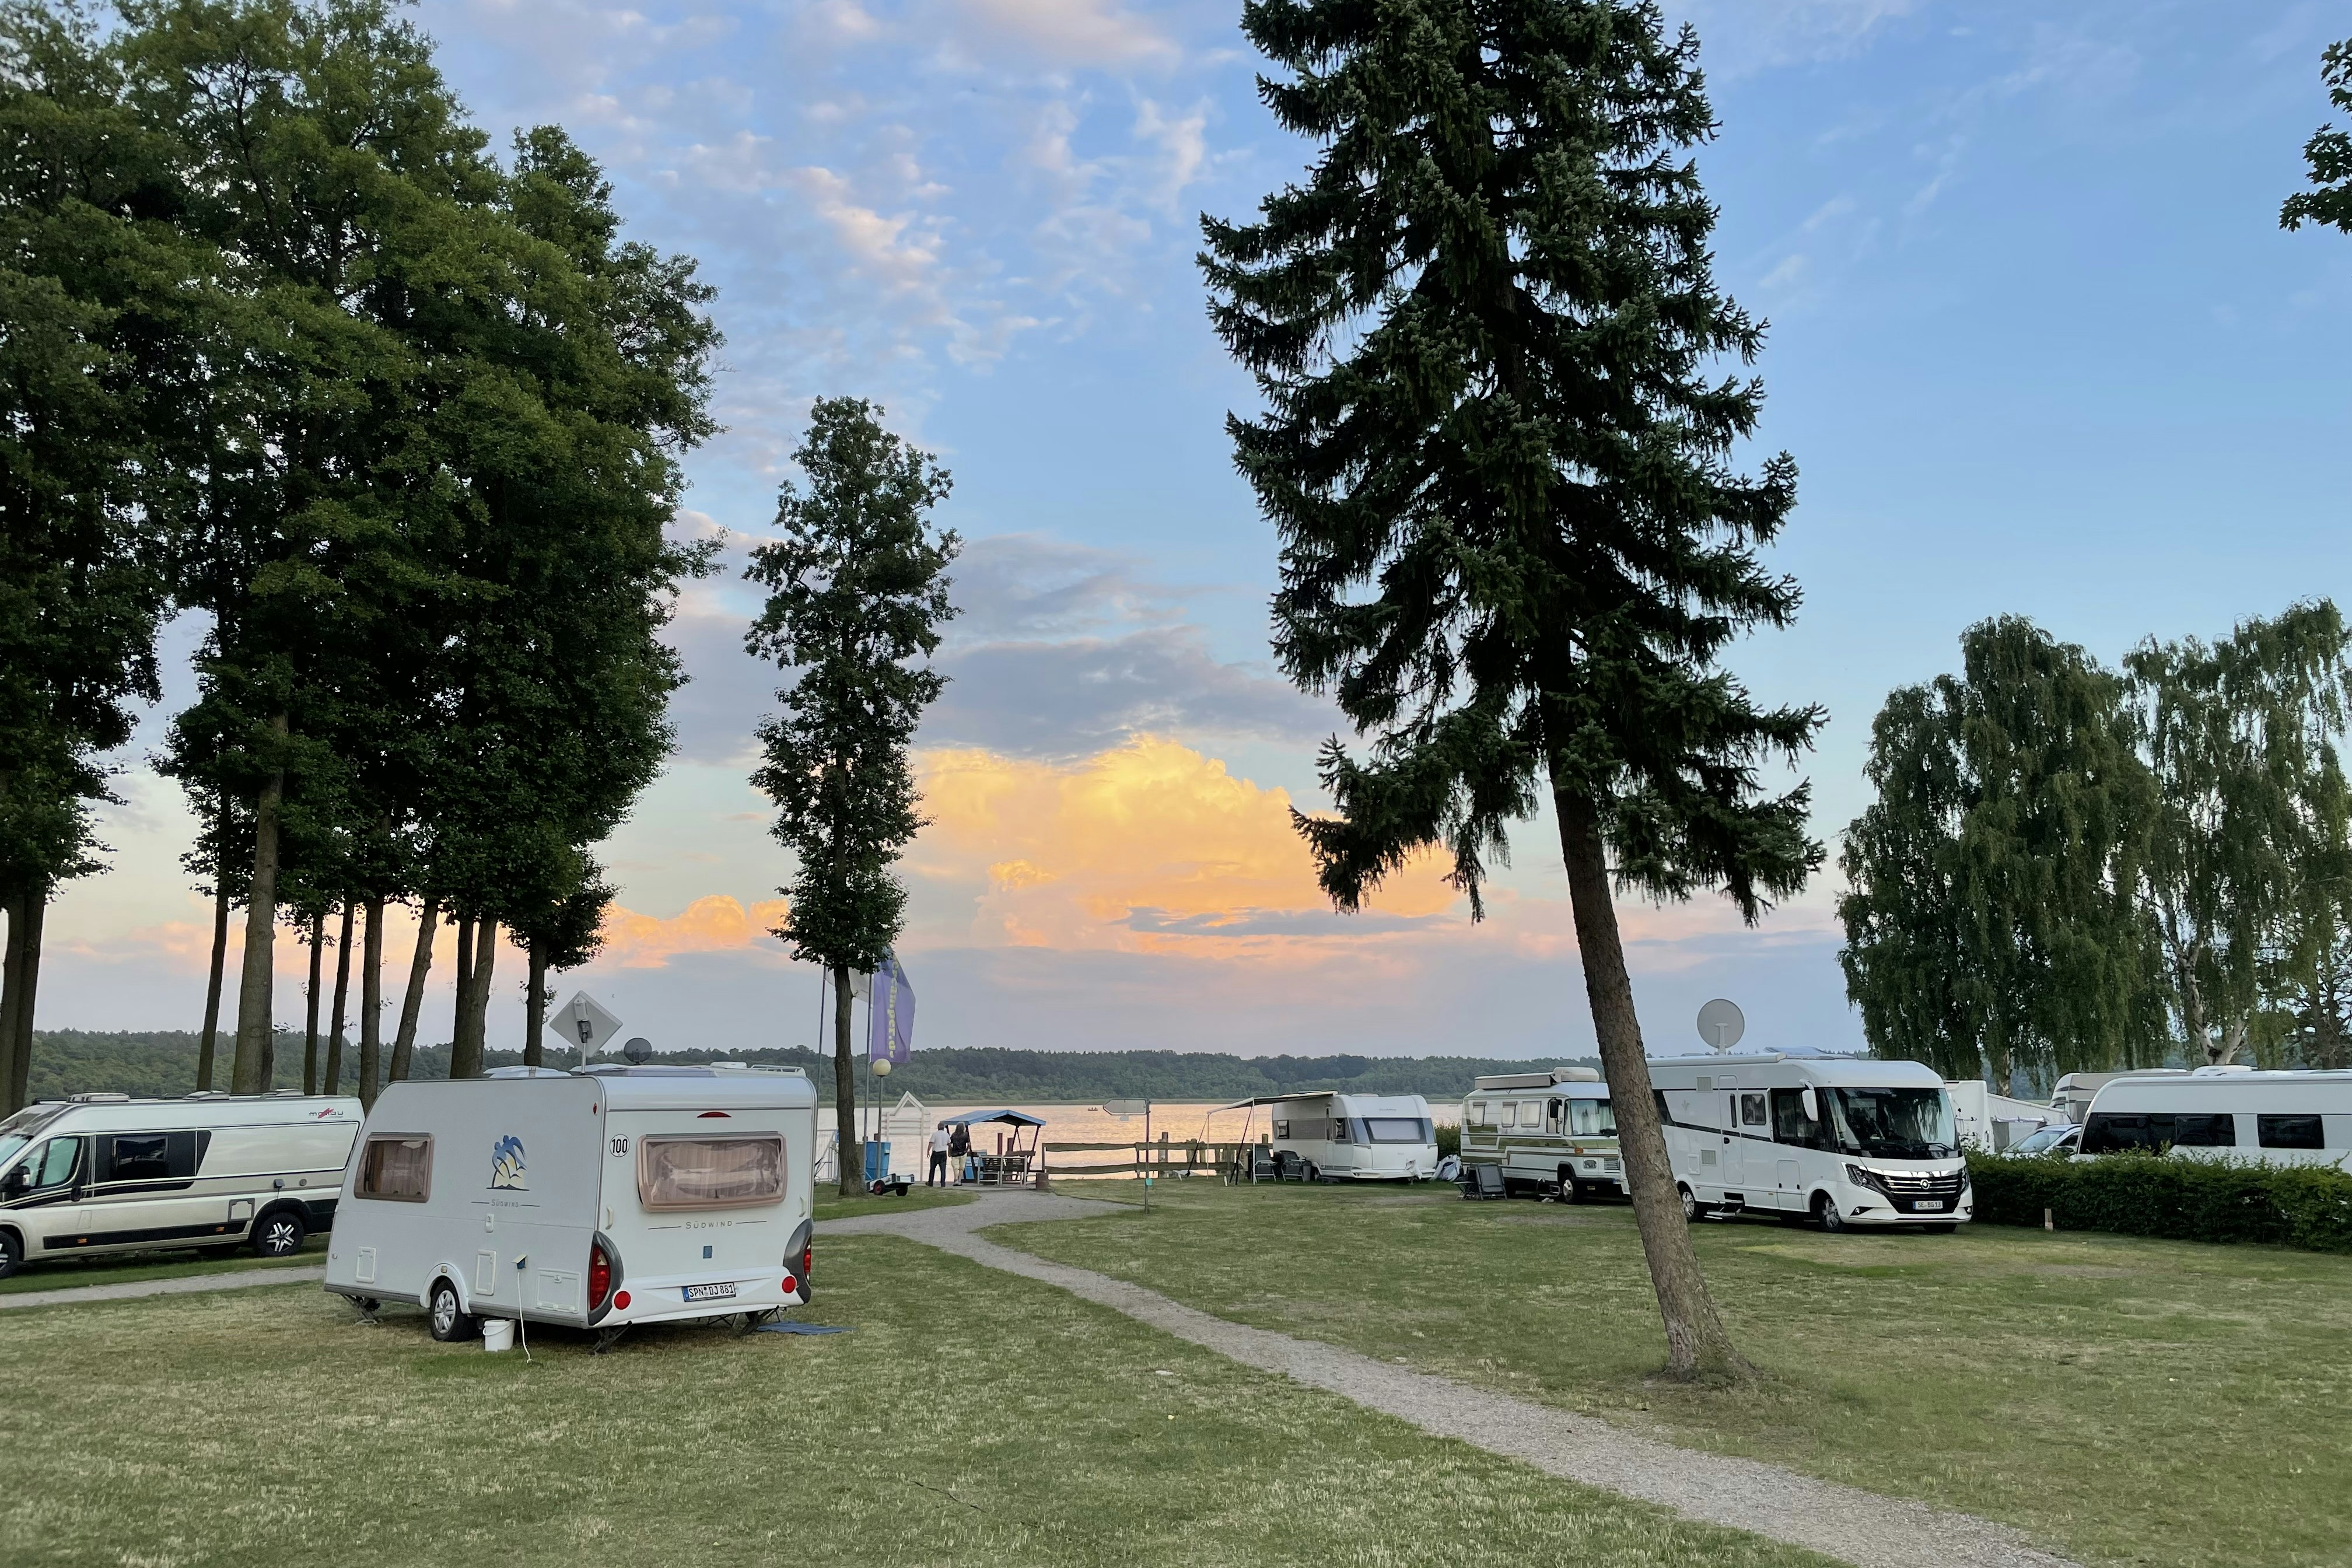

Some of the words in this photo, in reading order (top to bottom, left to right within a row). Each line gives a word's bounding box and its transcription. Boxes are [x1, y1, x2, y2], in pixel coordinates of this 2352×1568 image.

[612, 1139, 628, 1153] 100
[686, 1220, 732, 1229] SÜDWIND
[689, 1287, 704, 1297] SPN
[709, 1286, 719, 1295] DJ
[720, 1284, 734, 1294] 881
